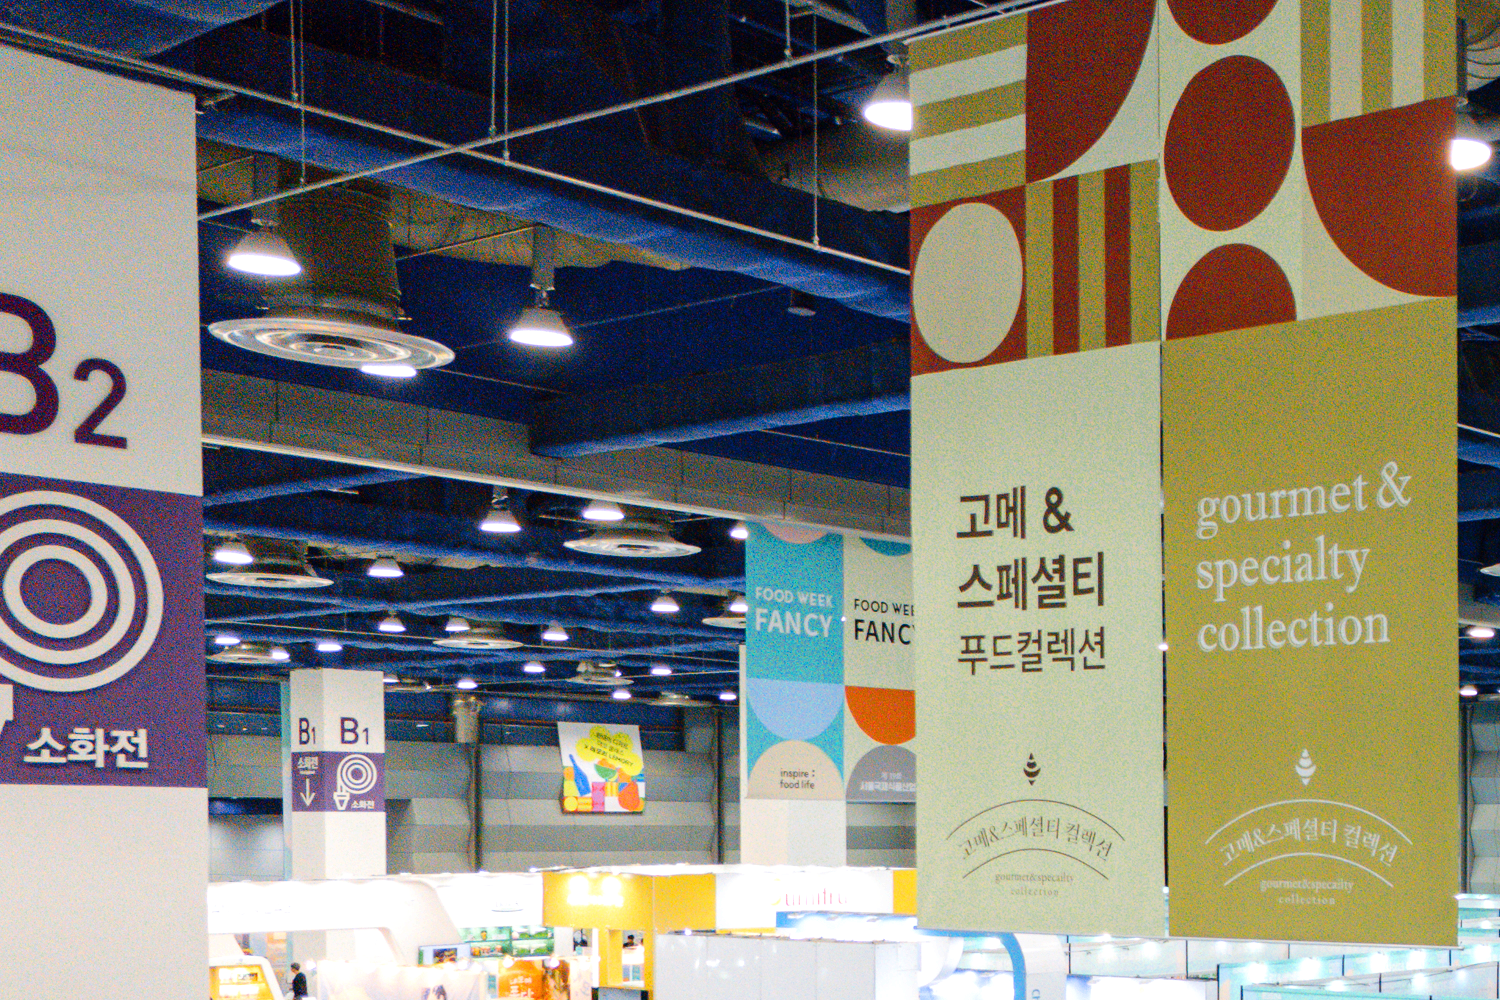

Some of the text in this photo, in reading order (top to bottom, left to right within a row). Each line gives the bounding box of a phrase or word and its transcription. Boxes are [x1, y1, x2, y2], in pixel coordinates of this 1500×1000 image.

[956, 485, 1075, 540] 고메 &
[1196, 460, 1412, 540] gourmet &
[957, 551, 1105, 611] 스페셜티
[1196, 535, 1371, 603] specialty
[754, 586, 834, 609] FOOD WEEK
[853, 598, 915, 617] FOOD WEE
[754, 607, 833, 638] FANCY
[853, 618, 916, 646] FANC
[1197, 602, 1391, 654] collection
[957, 625, 1107, 676] 푸드컬렉션
[23, 725, 150, 771] 소화전
[298, 717, 317, 745] B1
[339, 716, 370, 745] B1
[780, 768, 810, 780] inspire
[958, 815, 1113, 862] 고메&스페셜티 컬렉션
[1219, 817, 1398, 867] 고메&스페셜티 컬렉션
